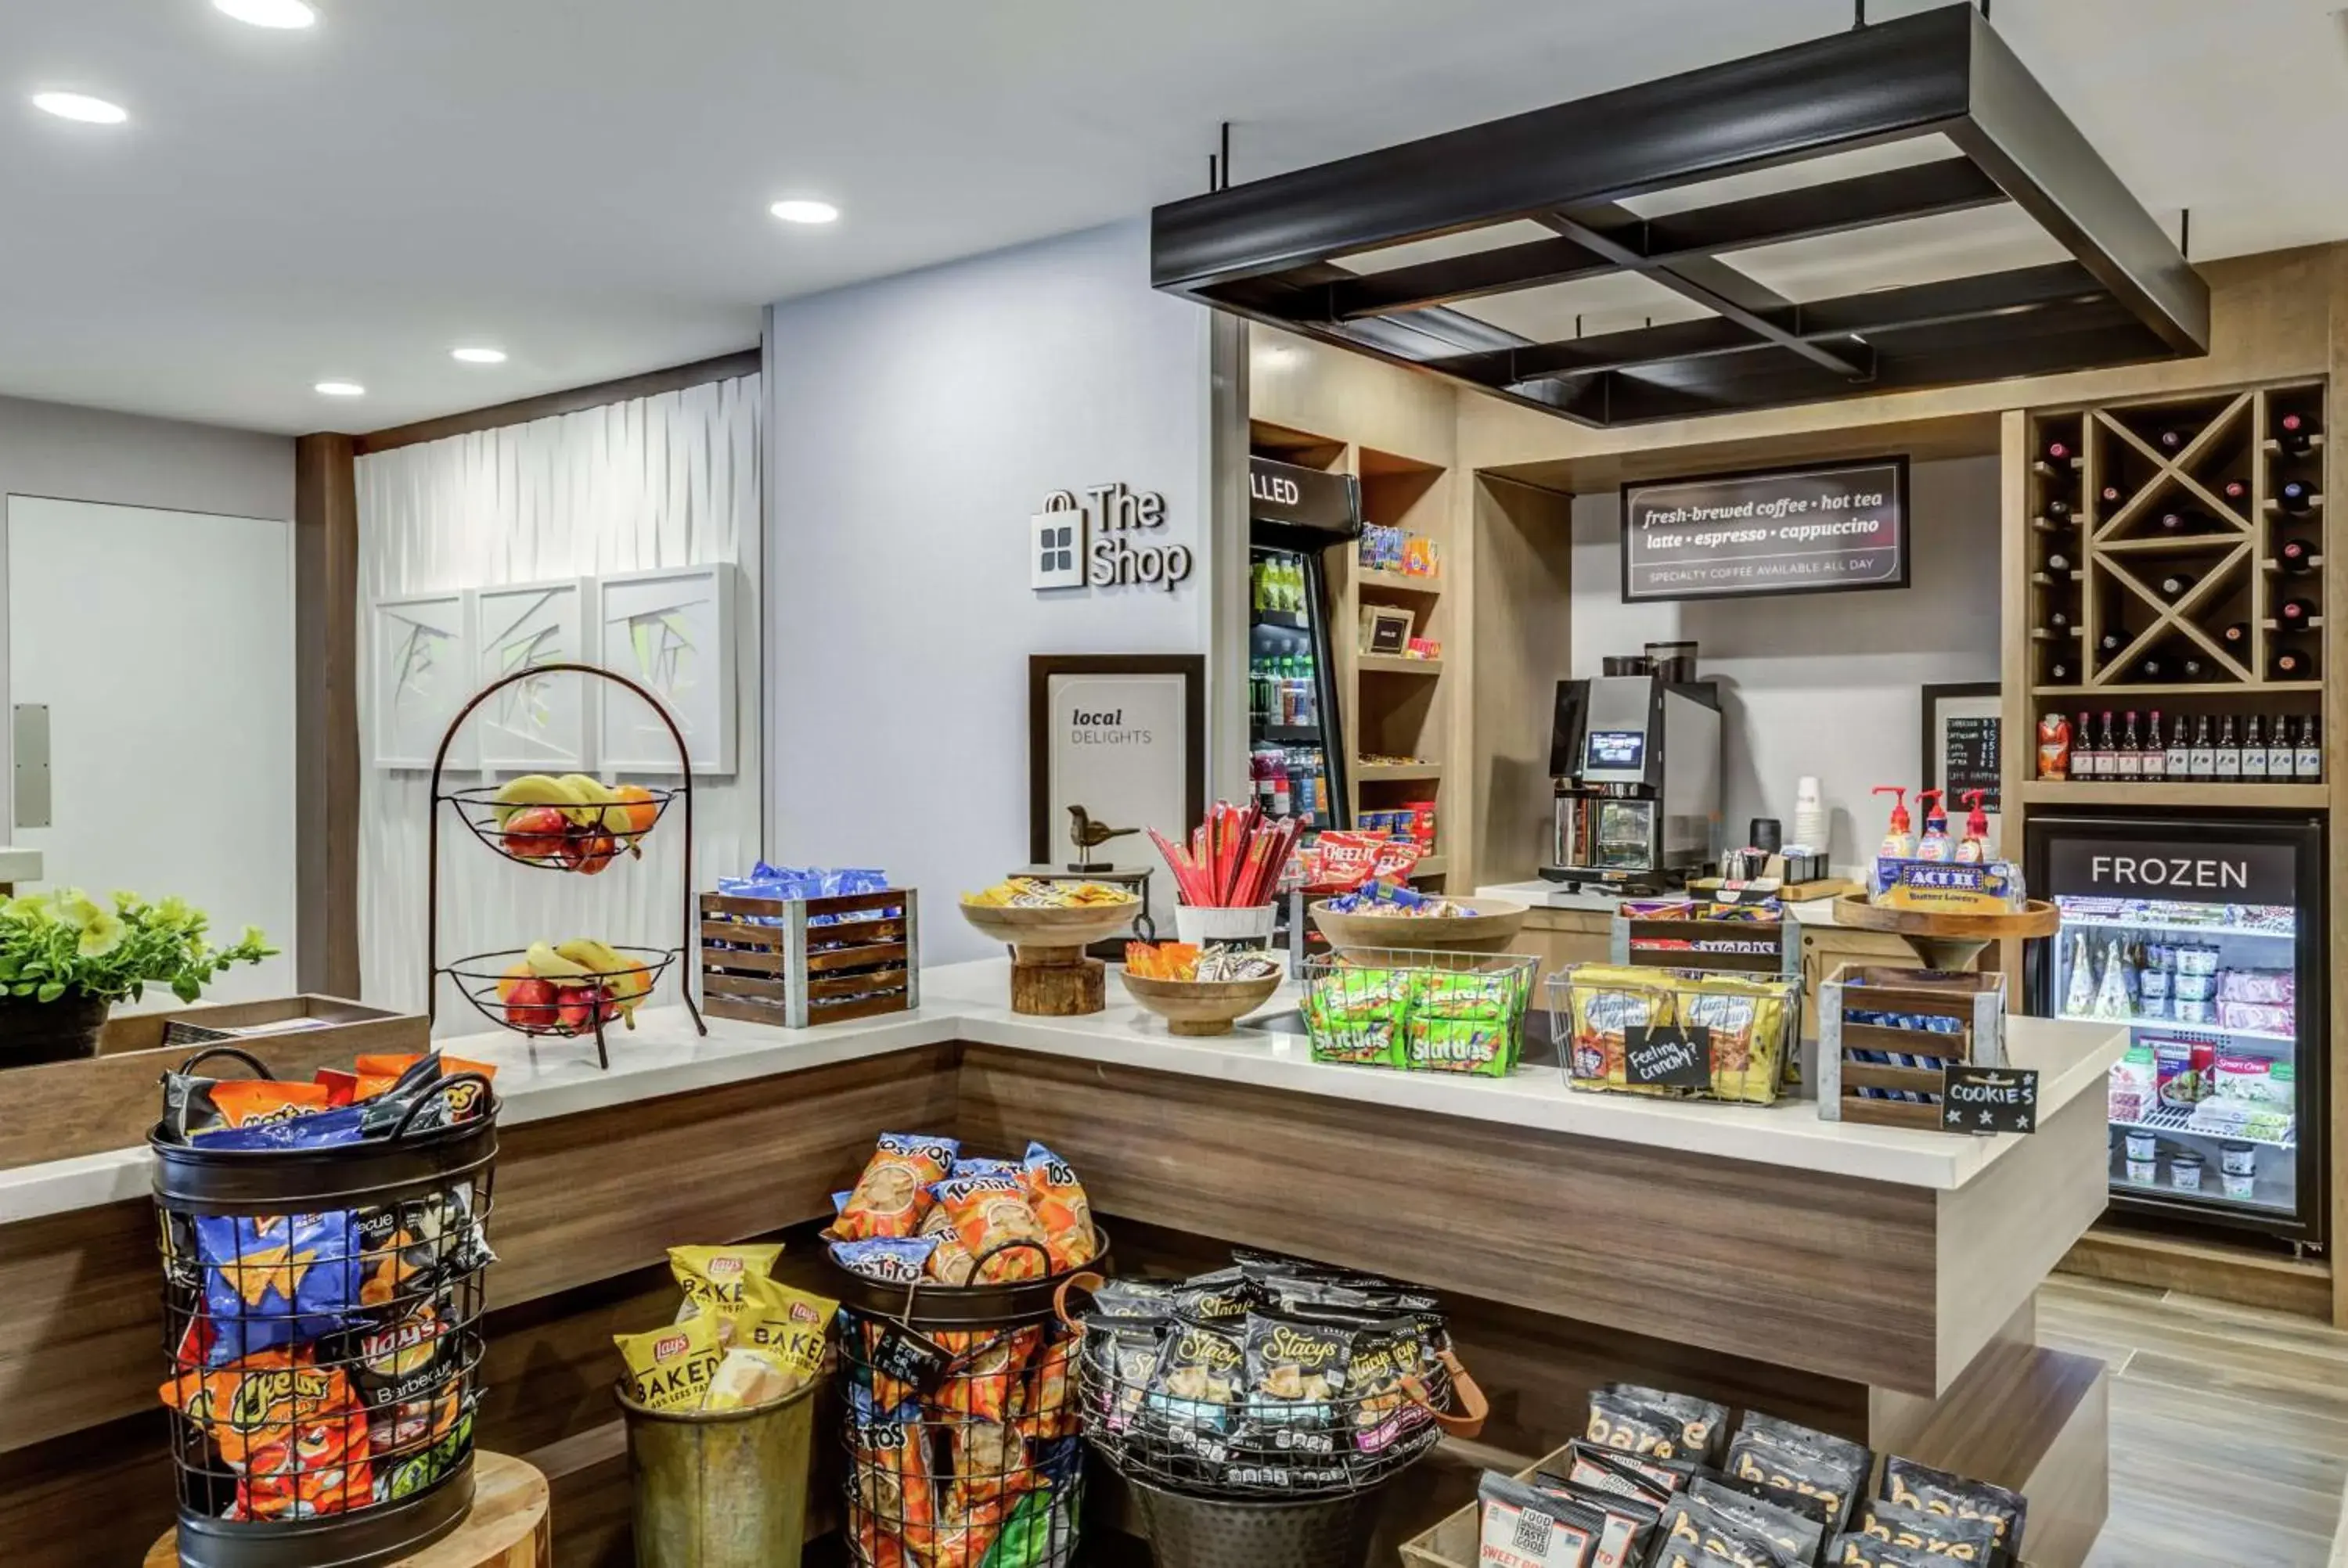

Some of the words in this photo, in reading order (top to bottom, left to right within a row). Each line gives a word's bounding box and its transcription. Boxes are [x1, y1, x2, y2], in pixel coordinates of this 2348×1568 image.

[1087, 483, 1165, 533] The
[1642, 501, 1754, 530] fresh-brewed
[1756, 497, 1809, 518] coffee
[1820, 494, 1850, 511] hot
[1853, 492, 1883, 508] tea
[1646, 533, 1683, 549] latte
[1694, 529, 1767, 548] espresso
[1779, 516, 1879, 542] cappuccino
[1089, 537, 1193, 592] Shop
[1649, 570, 1706, 584] SPECIALTY
[1710, 566, 1753, 579] COFFEE
[1756, 563, 1820, 576] AVAILABLE
[1823, 561, 1846, 571] ALL
[1849, 558, 1875, 571] DAY
[1072, 707, 1122, 726] local
[1071, 729, 1153, 745] DELIGHTS
[1910, 871, 1951, 885] ACT
[2091, 856, 2248, 889] FROZEN
[1628, 1041, 1680, 1069] Feeling
[1950, 1084, 2035, 1105] COOKIES
[636, 1356, 720, 1404] BAKED
[1523, 1510, 1552, 1527] FOOD
[1518, 1527, 1547, 1545] TASTE
